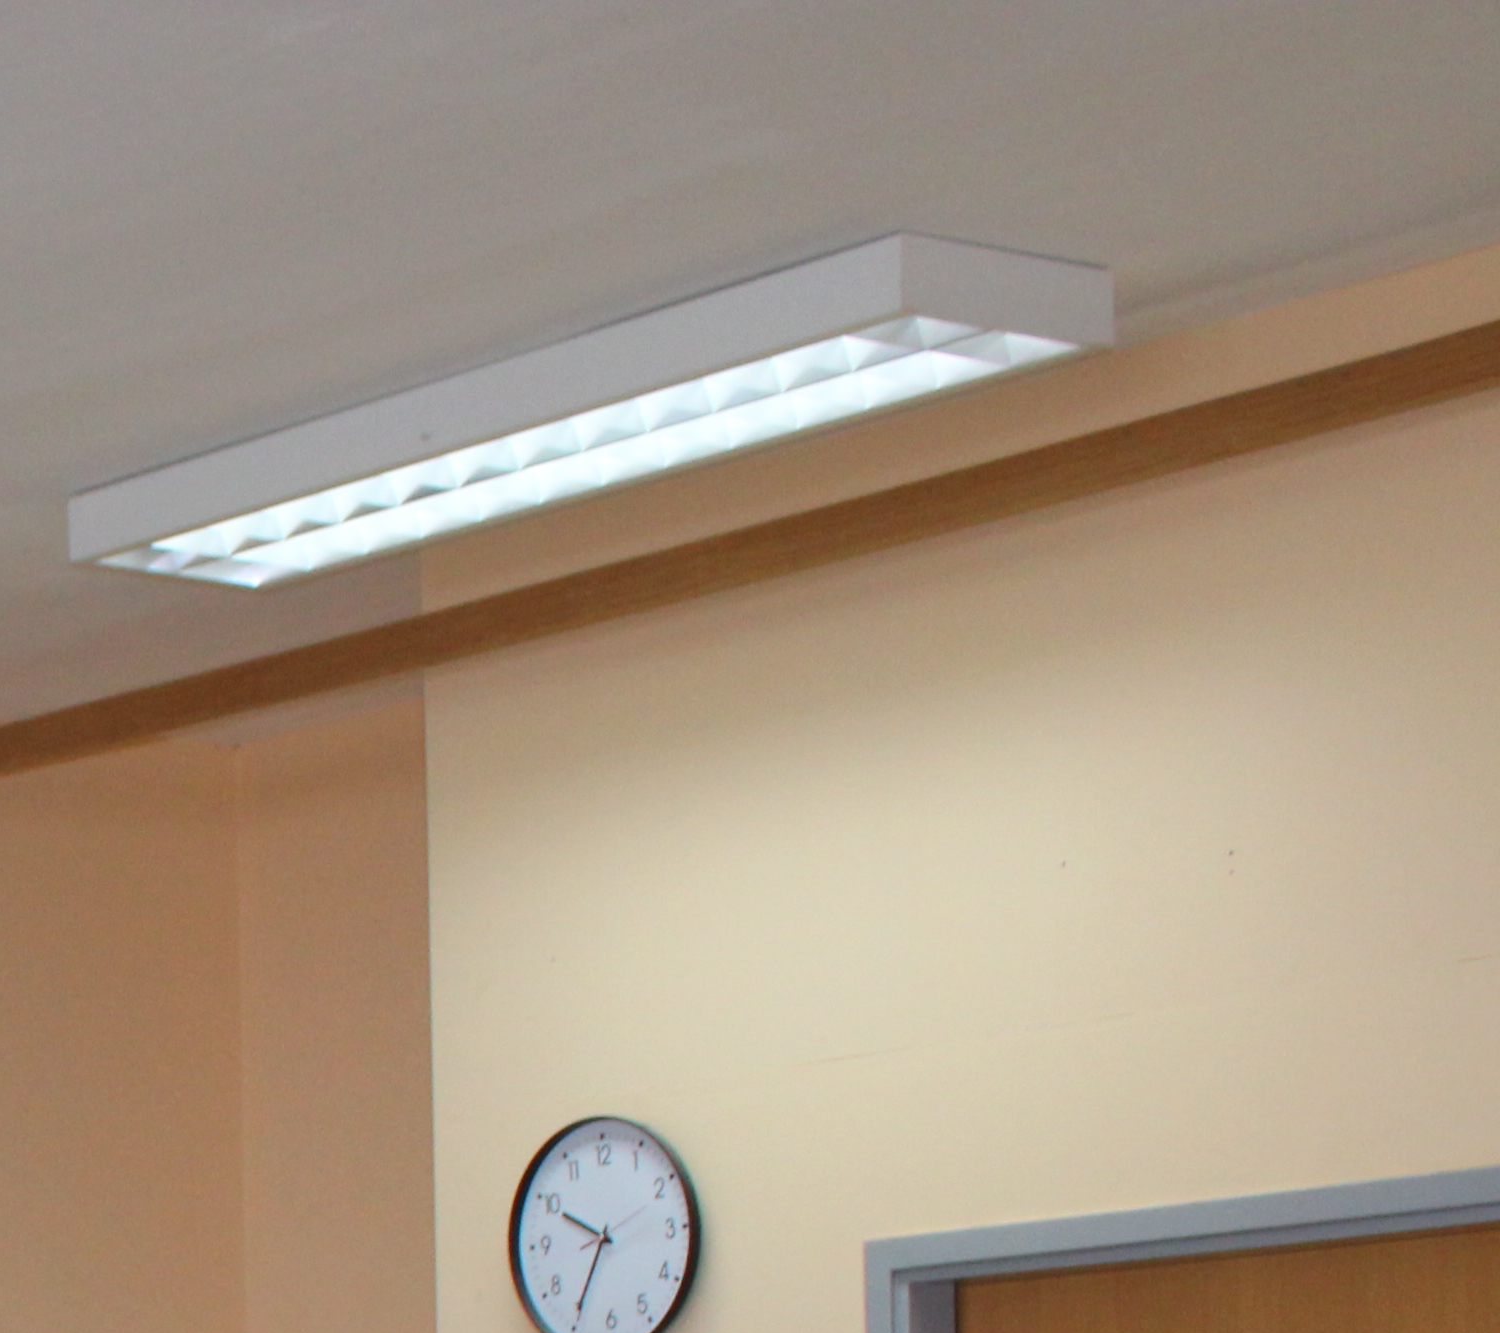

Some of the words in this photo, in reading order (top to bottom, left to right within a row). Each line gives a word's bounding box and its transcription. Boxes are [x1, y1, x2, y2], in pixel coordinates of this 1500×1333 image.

[596, 1144, 612, 1166] 12
[633, 1151, 639, 1172] 1
[567, 1160, 580, 1182] 11
[653, 1177, 666, 1200] 2
[544, 1193, 561, 1216] 10
[665, 1217, 676, 1240] 3
[540, 1235, 551, 1256] 9
[658, 1260, 670, 1281] 4
[550, 1274, 562, 1296] 8
[636, 1293, 649, 1315] 5
[605, 1308, 618, 1331] 6
